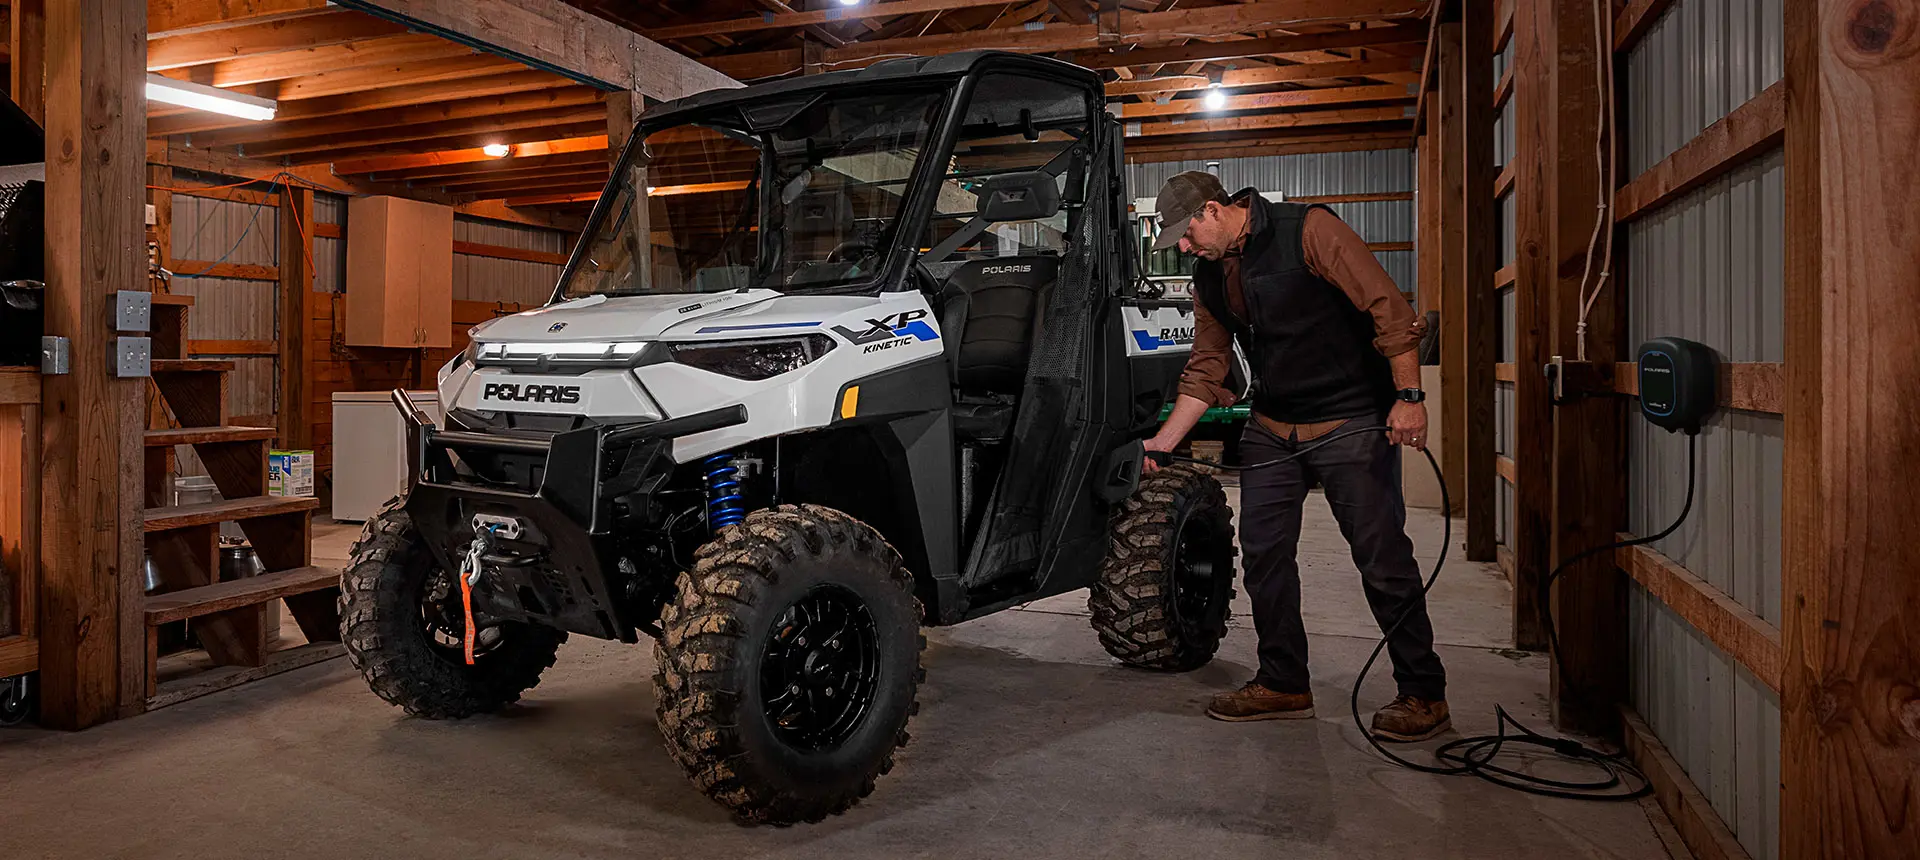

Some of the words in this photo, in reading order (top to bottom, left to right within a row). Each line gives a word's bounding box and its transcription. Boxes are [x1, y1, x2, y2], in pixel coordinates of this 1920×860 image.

[982, 264, 1031, 274] POLARIS
[858, 308, 928, 339] XP
[863, 336, 913, 354] KINETIC
[483, 383, 581, 404] POLARIS
